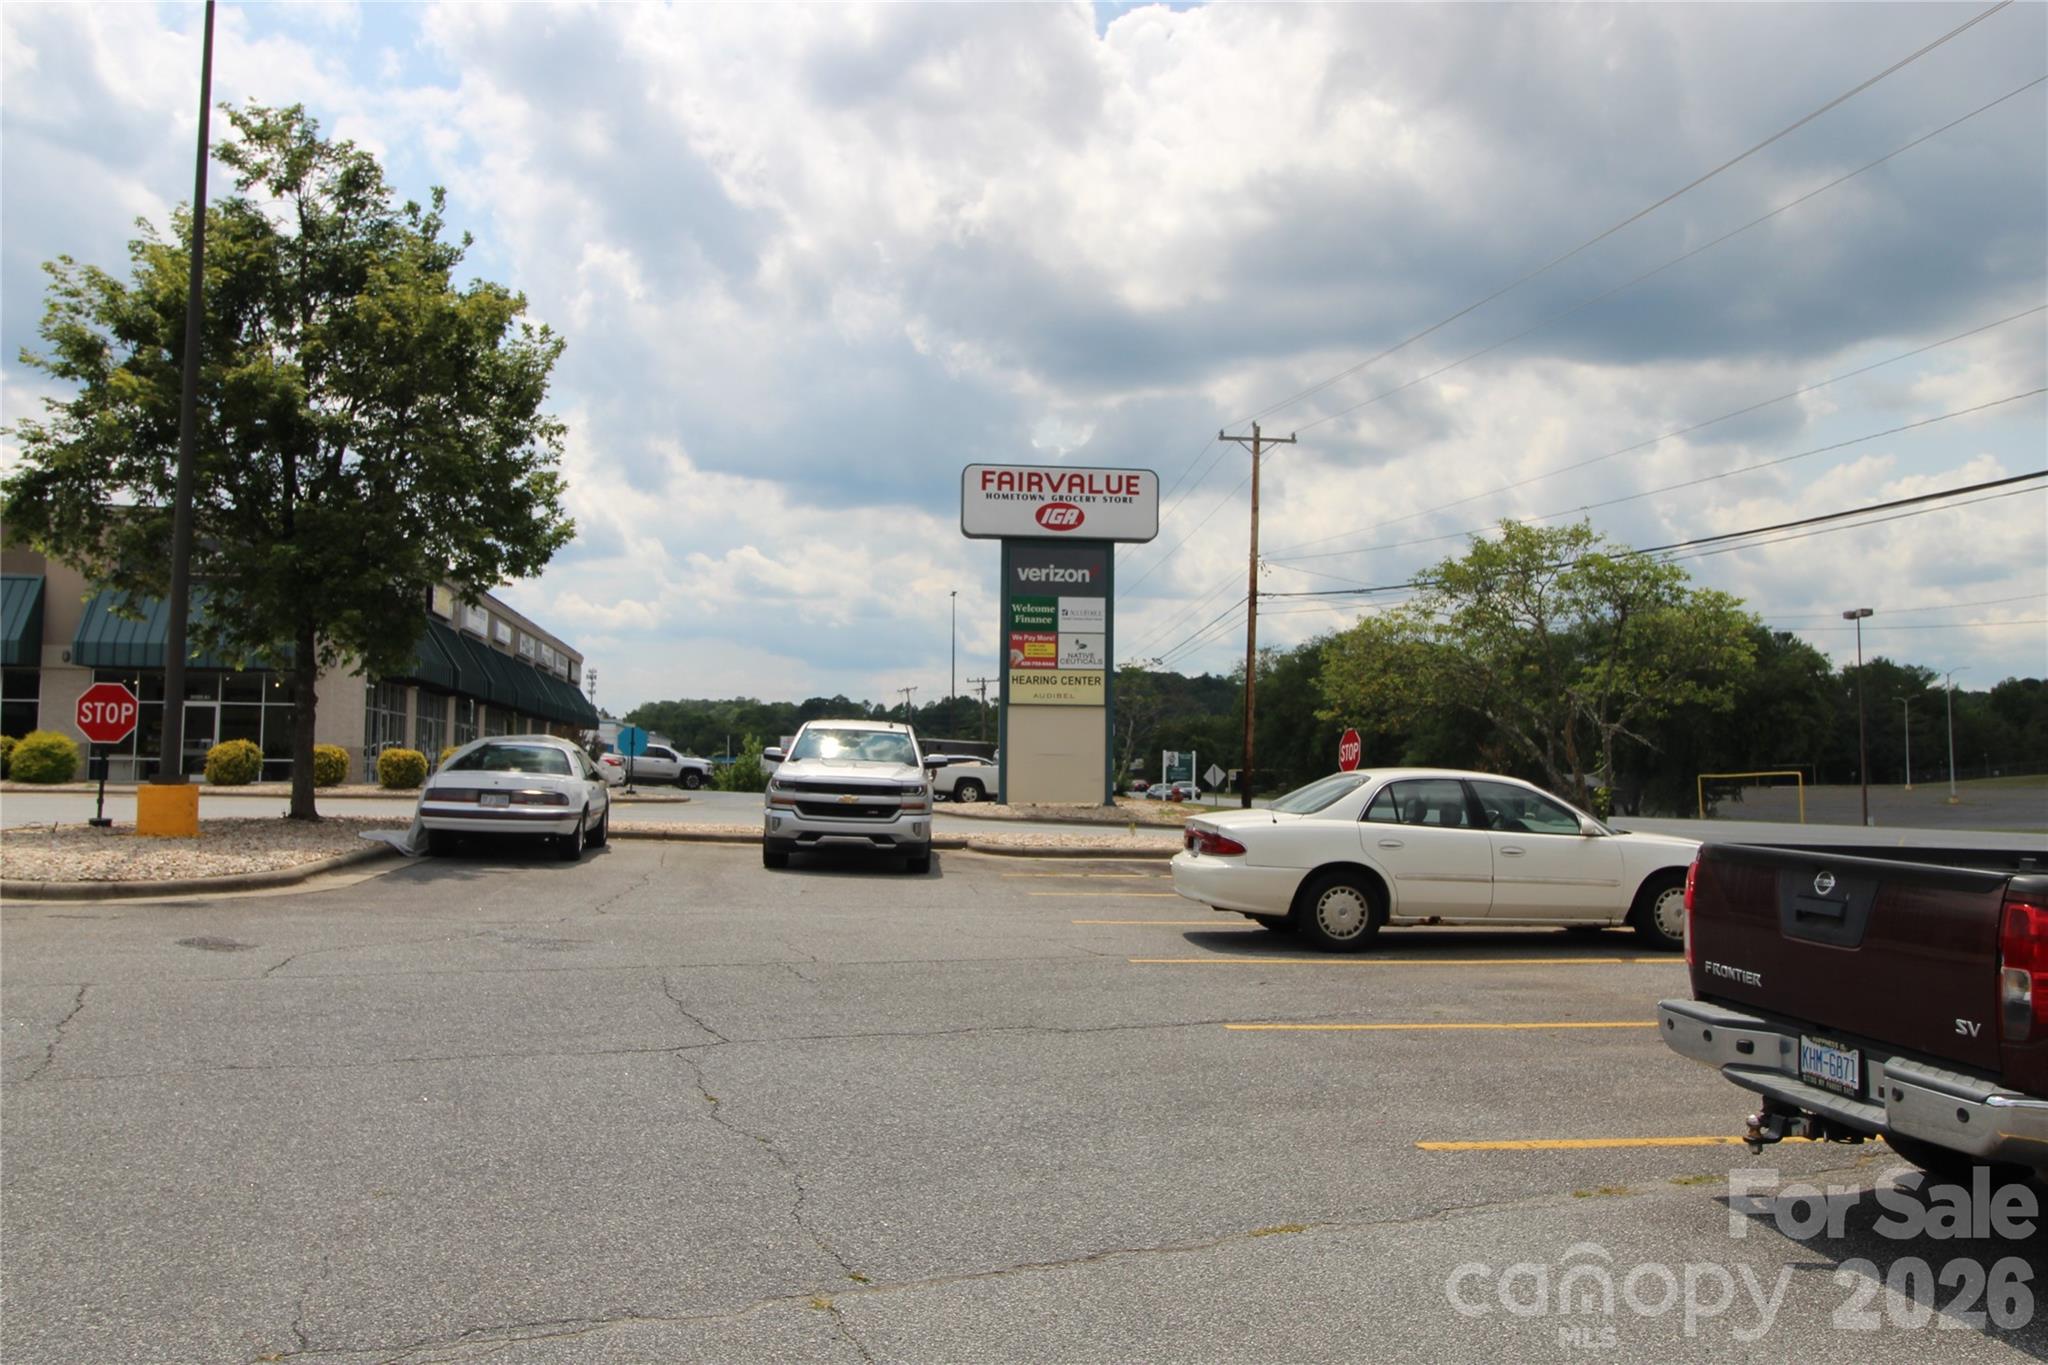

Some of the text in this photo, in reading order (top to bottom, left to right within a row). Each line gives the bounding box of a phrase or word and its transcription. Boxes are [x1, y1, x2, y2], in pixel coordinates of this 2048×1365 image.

[981, 470, 1140, 496] FAIRVALUE
[985, 492, 1134, 504] HOMETOWN GROCERY STORE
[1041, 508, 1080, 525] IGA
[1017, 564, 1090, 583] verizon
[1011, 603, 1056, 614] Welcome
[1014, 614, 1053, 625] Finance
[1023, 634, 1036, 643] Pay
[1011, 675, 1102, 686] HEARING CENTER
[80, 702, 134, 725] STOP
[1340, 742, 1359, 763] STOP
[1704, 960, 1762, 987] FRONTIER
[1955, 1018, 1982, 1038] SV
[1801, 1045, 1857, 1084] KHM-6871
